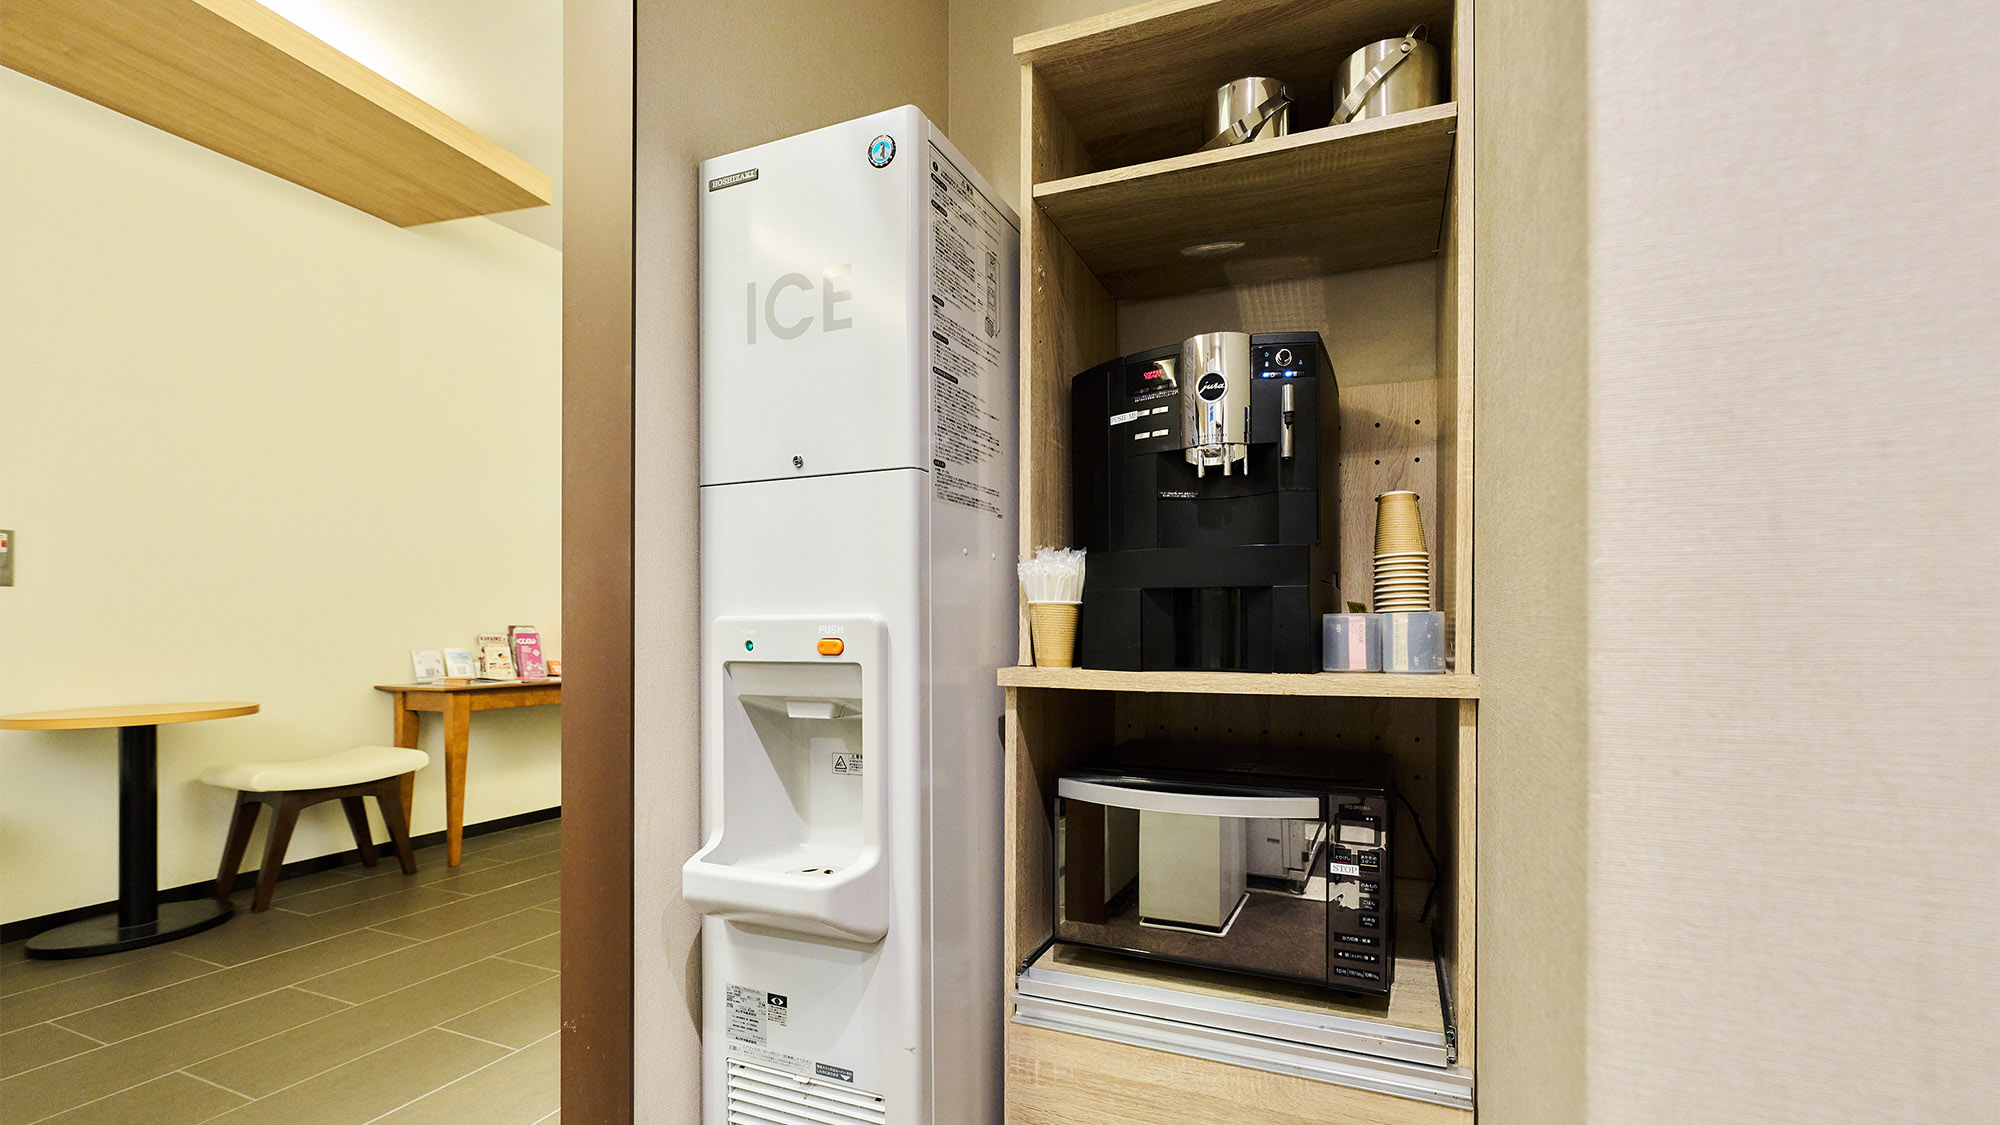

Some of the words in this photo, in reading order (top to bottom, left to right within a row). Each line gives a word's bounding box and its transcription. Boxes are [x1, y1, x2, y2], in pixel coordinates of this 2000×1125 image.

[711, 169, 756, 189] HOSHIZAKI
[746, 262, 853, 346] ICE
[1198, 380, 1226, 394] jura
[818, 624, 845, 635] PUSH
[1332, 864, 1358, 875] STOP
